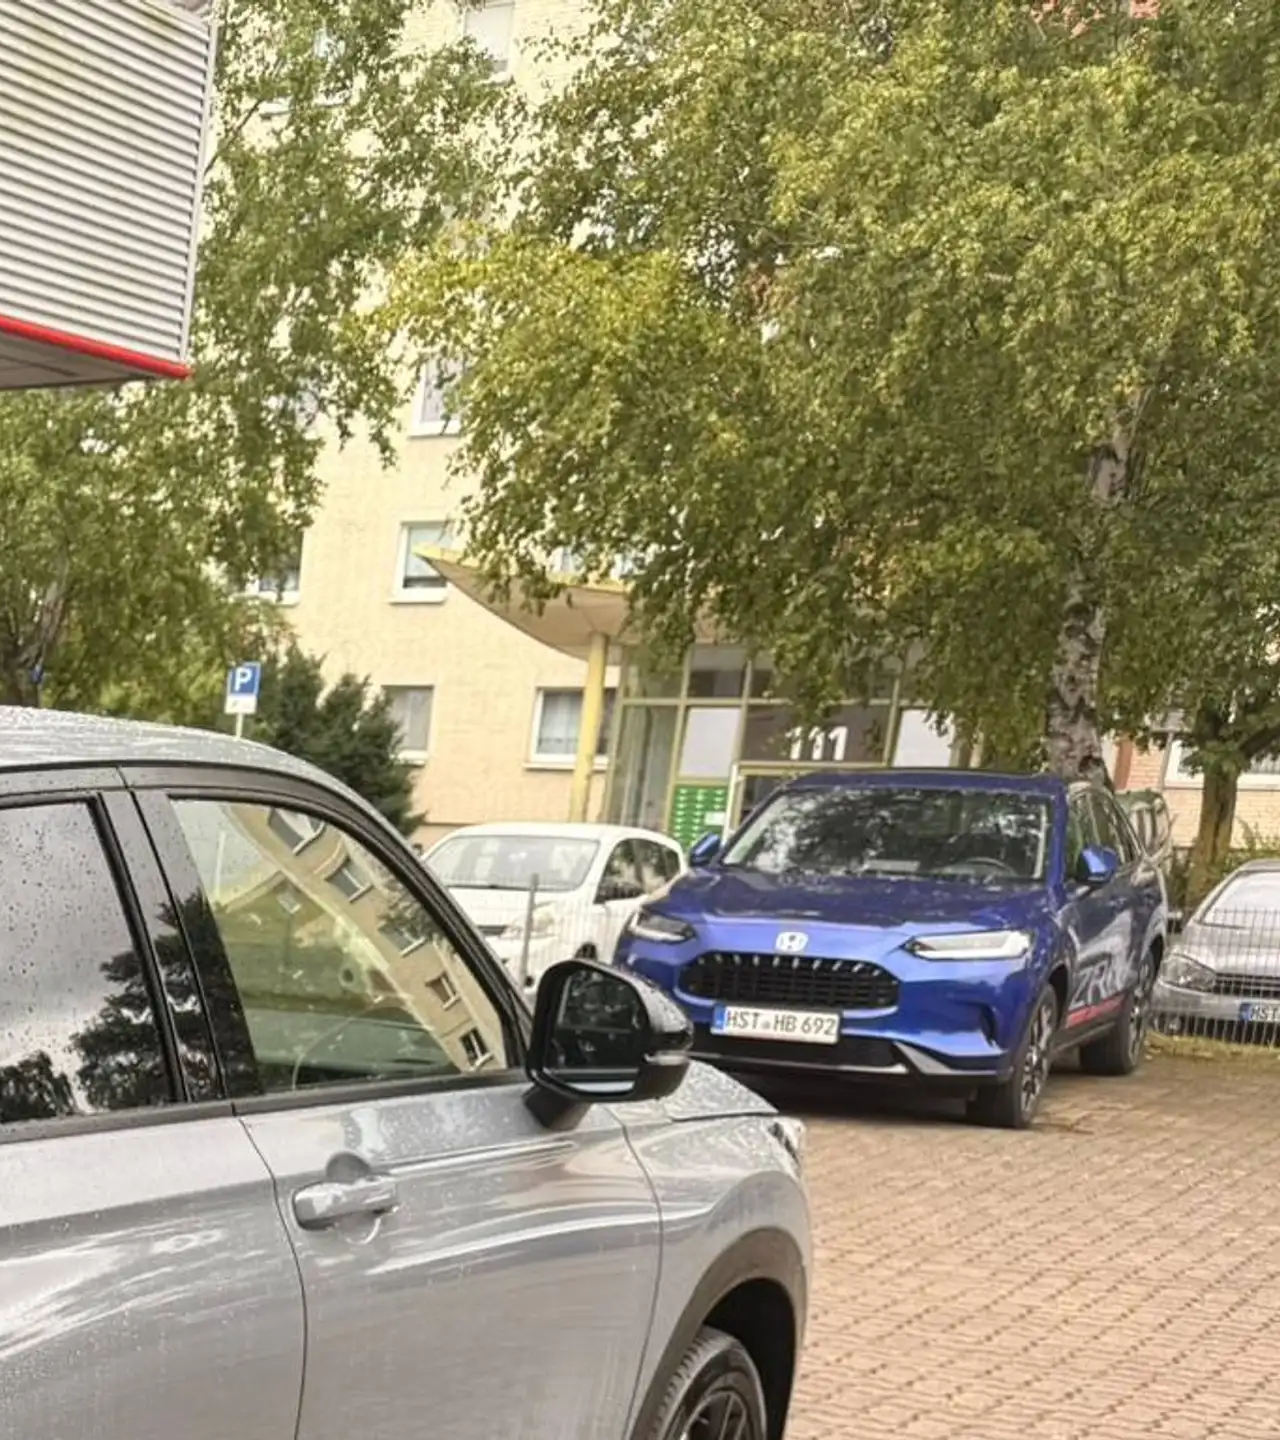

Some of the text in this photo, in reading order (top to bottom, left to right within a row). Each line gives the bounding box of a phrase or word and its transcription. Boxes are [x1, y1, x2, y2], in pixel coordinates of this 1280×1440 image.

[234, 666, 253, 692] P
[784, 725, 848, 761] 111
[726, 1009, 836, 1037] HST HB 692
